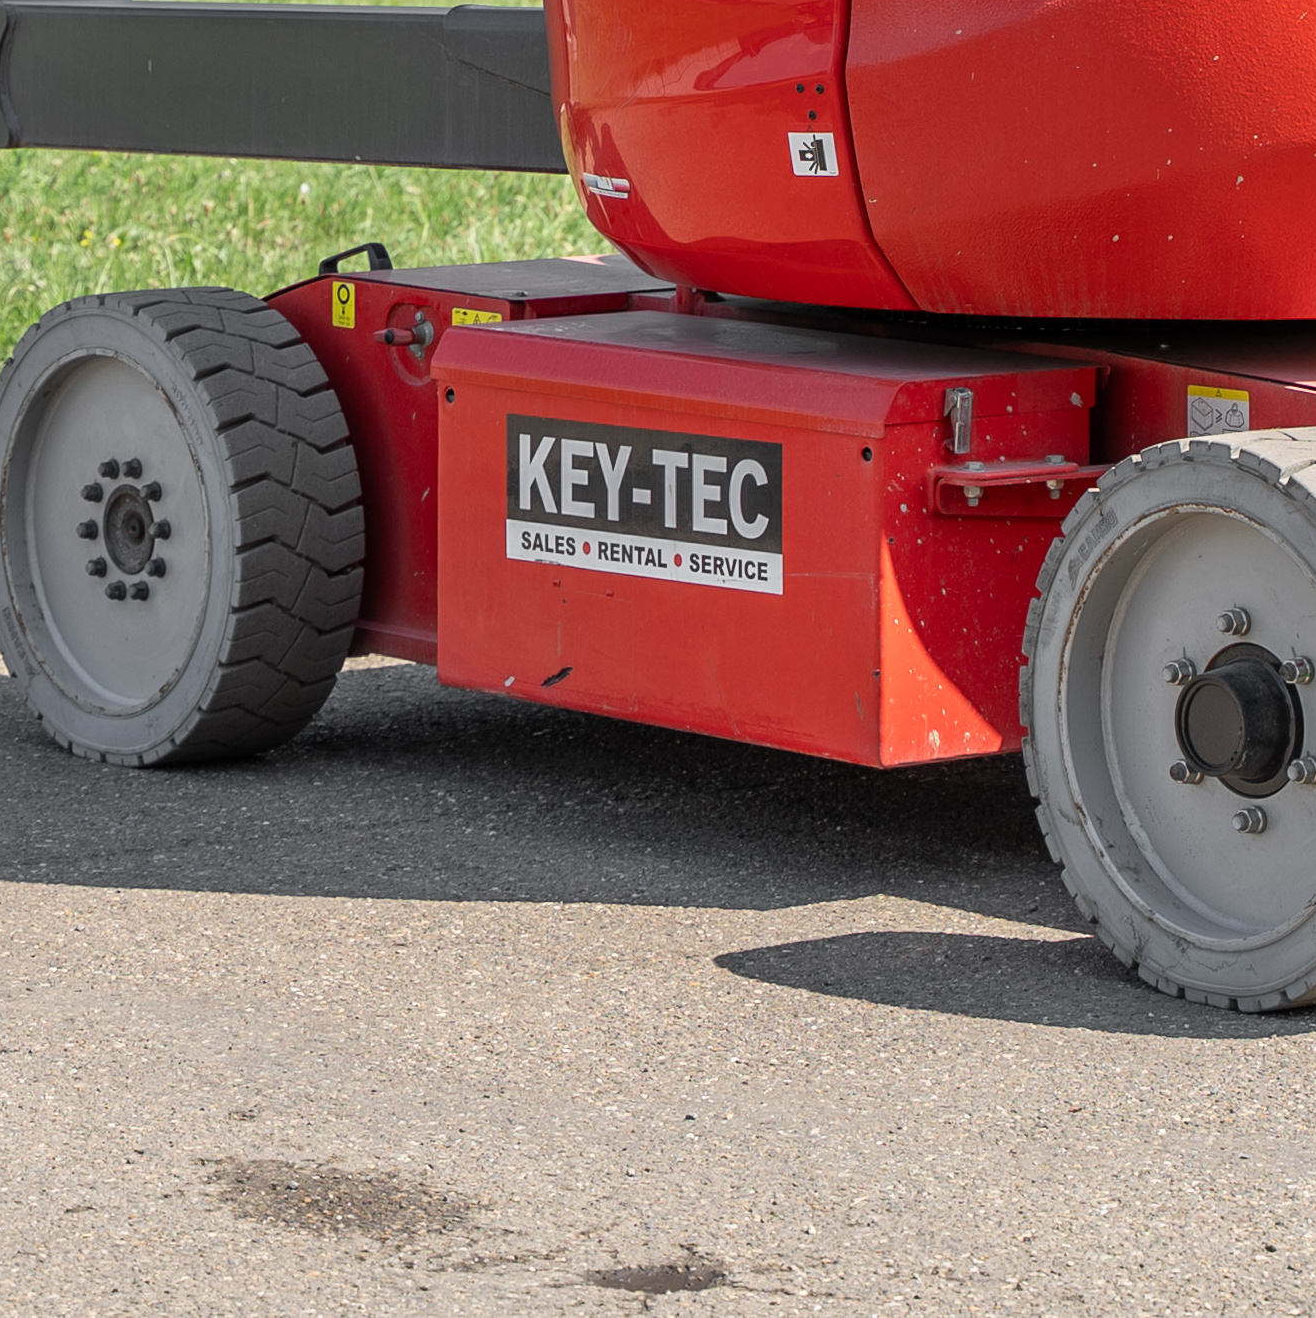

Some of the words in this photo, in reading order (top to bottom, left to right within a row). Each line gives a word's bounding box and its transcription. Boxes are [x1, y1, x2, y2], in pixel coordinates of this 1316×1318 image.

[518, 433, 770, 540] KEY-TEC
[521, 531, 576, 556] SALES
[597, 541, 668, 569] RENTAL
[688, 553, 769, 582] SERVICE
